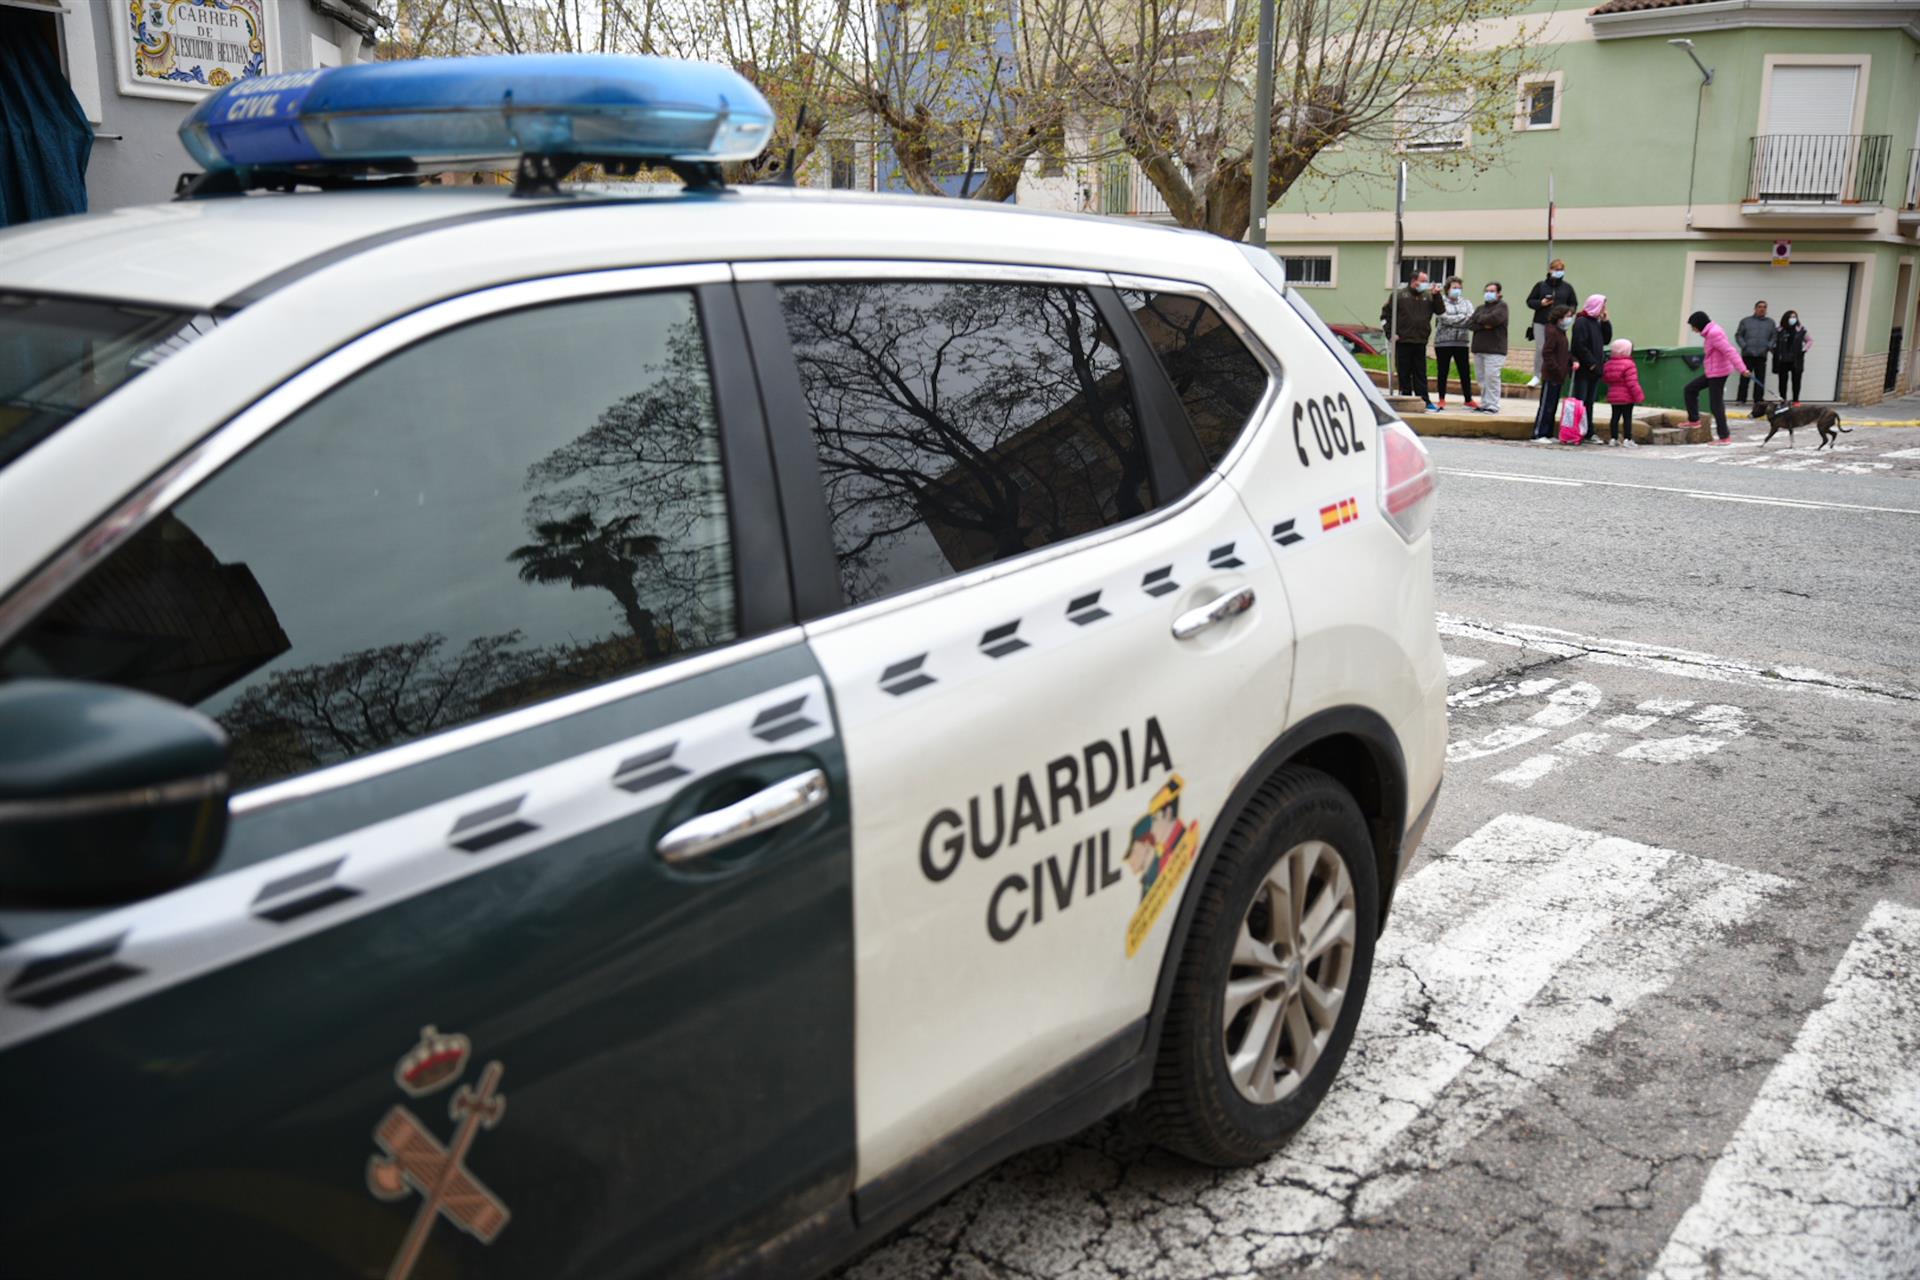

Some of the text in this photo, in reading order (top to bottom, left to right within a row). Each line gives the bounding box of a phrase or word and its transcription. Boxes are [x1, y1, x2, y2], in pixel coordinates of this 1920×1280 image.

[178, 6, 238, 28] CARRER
[197, 26, 213, 38] DE
[228, 93, 280, 121] CIVIL
[1306, 391, 1366, 460] 062
[919, 715, 1173, 883] GUARDIA
[986, 828, 1122, 944] CIVIL
